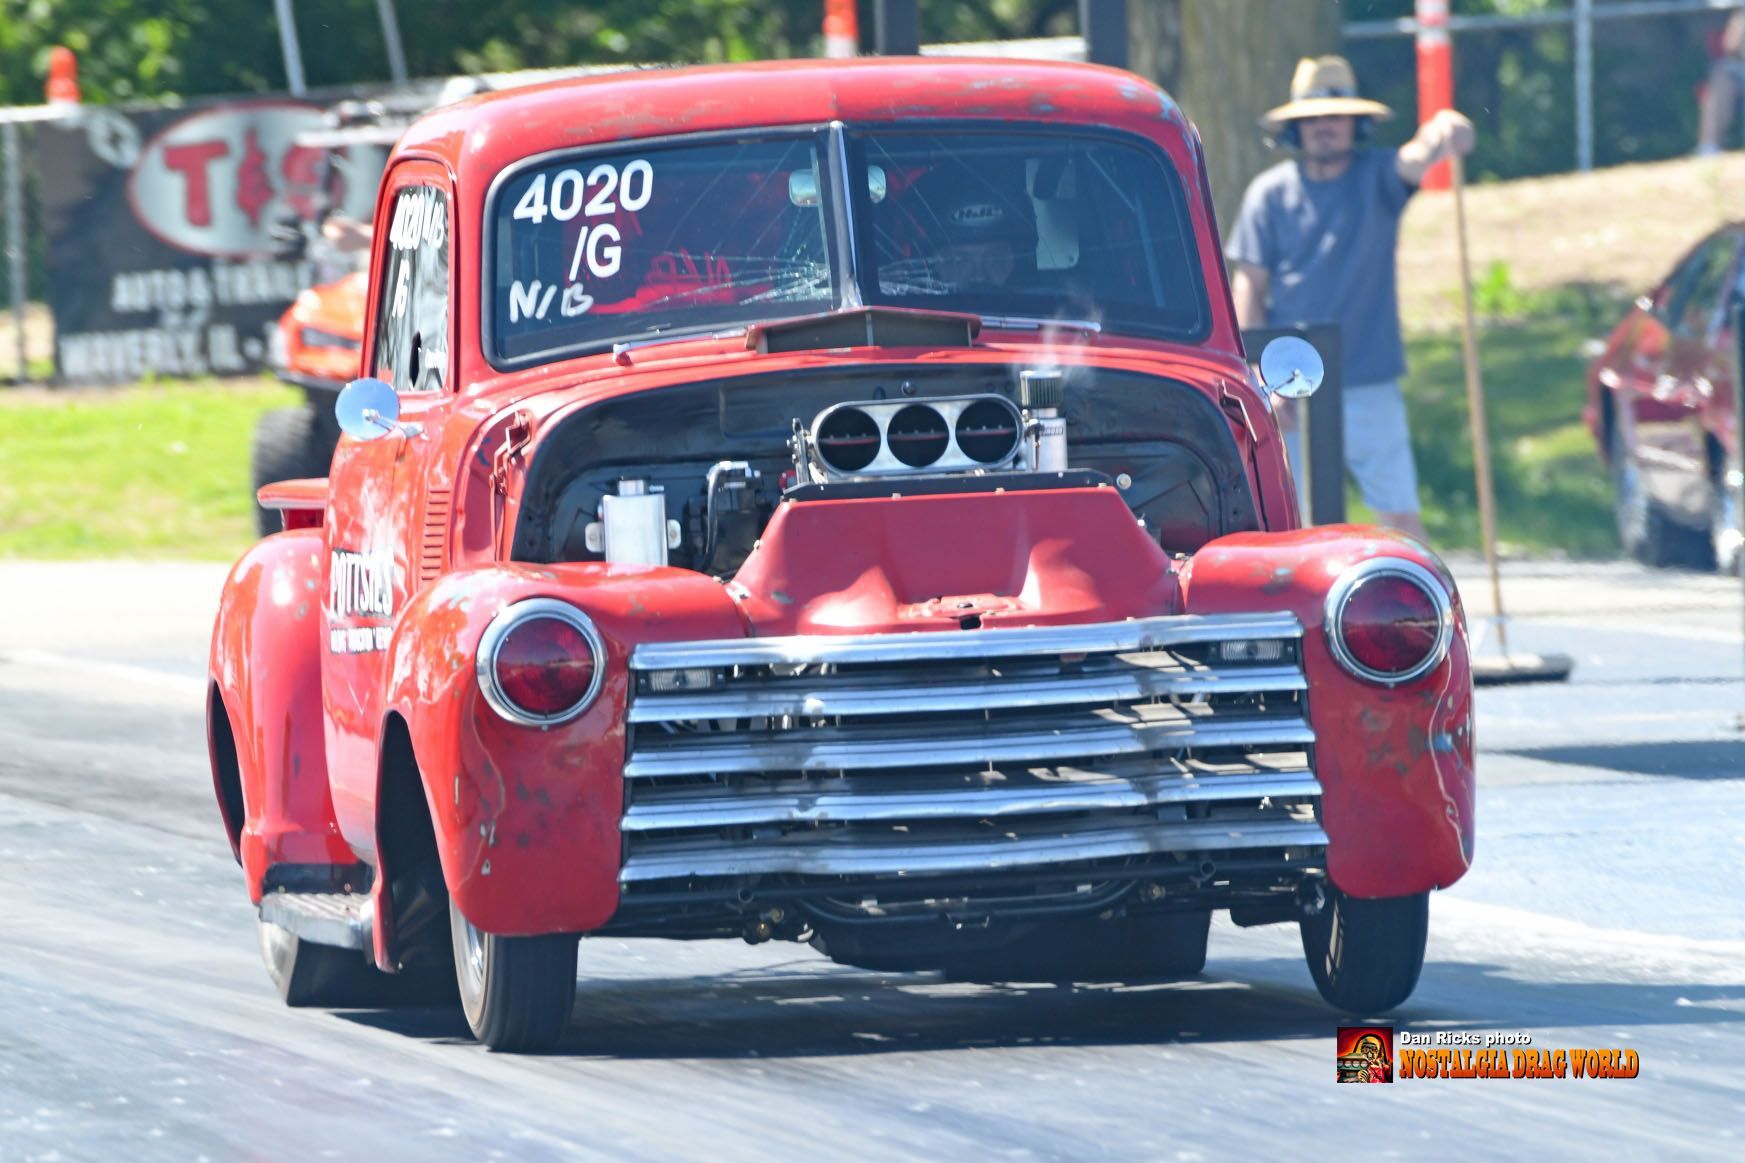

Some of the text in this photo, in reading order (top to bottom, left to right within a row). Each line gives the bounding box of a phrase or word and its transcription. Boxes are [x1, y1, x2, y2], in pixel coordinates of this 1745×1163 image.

[513, 159, 654, 224] 4020
[390, 193, 425, 250] 4020
[568, 223, 623, 282] /G
[112, 269, 186, 313] AUTO
[509, 279, 595, 324] N/B
